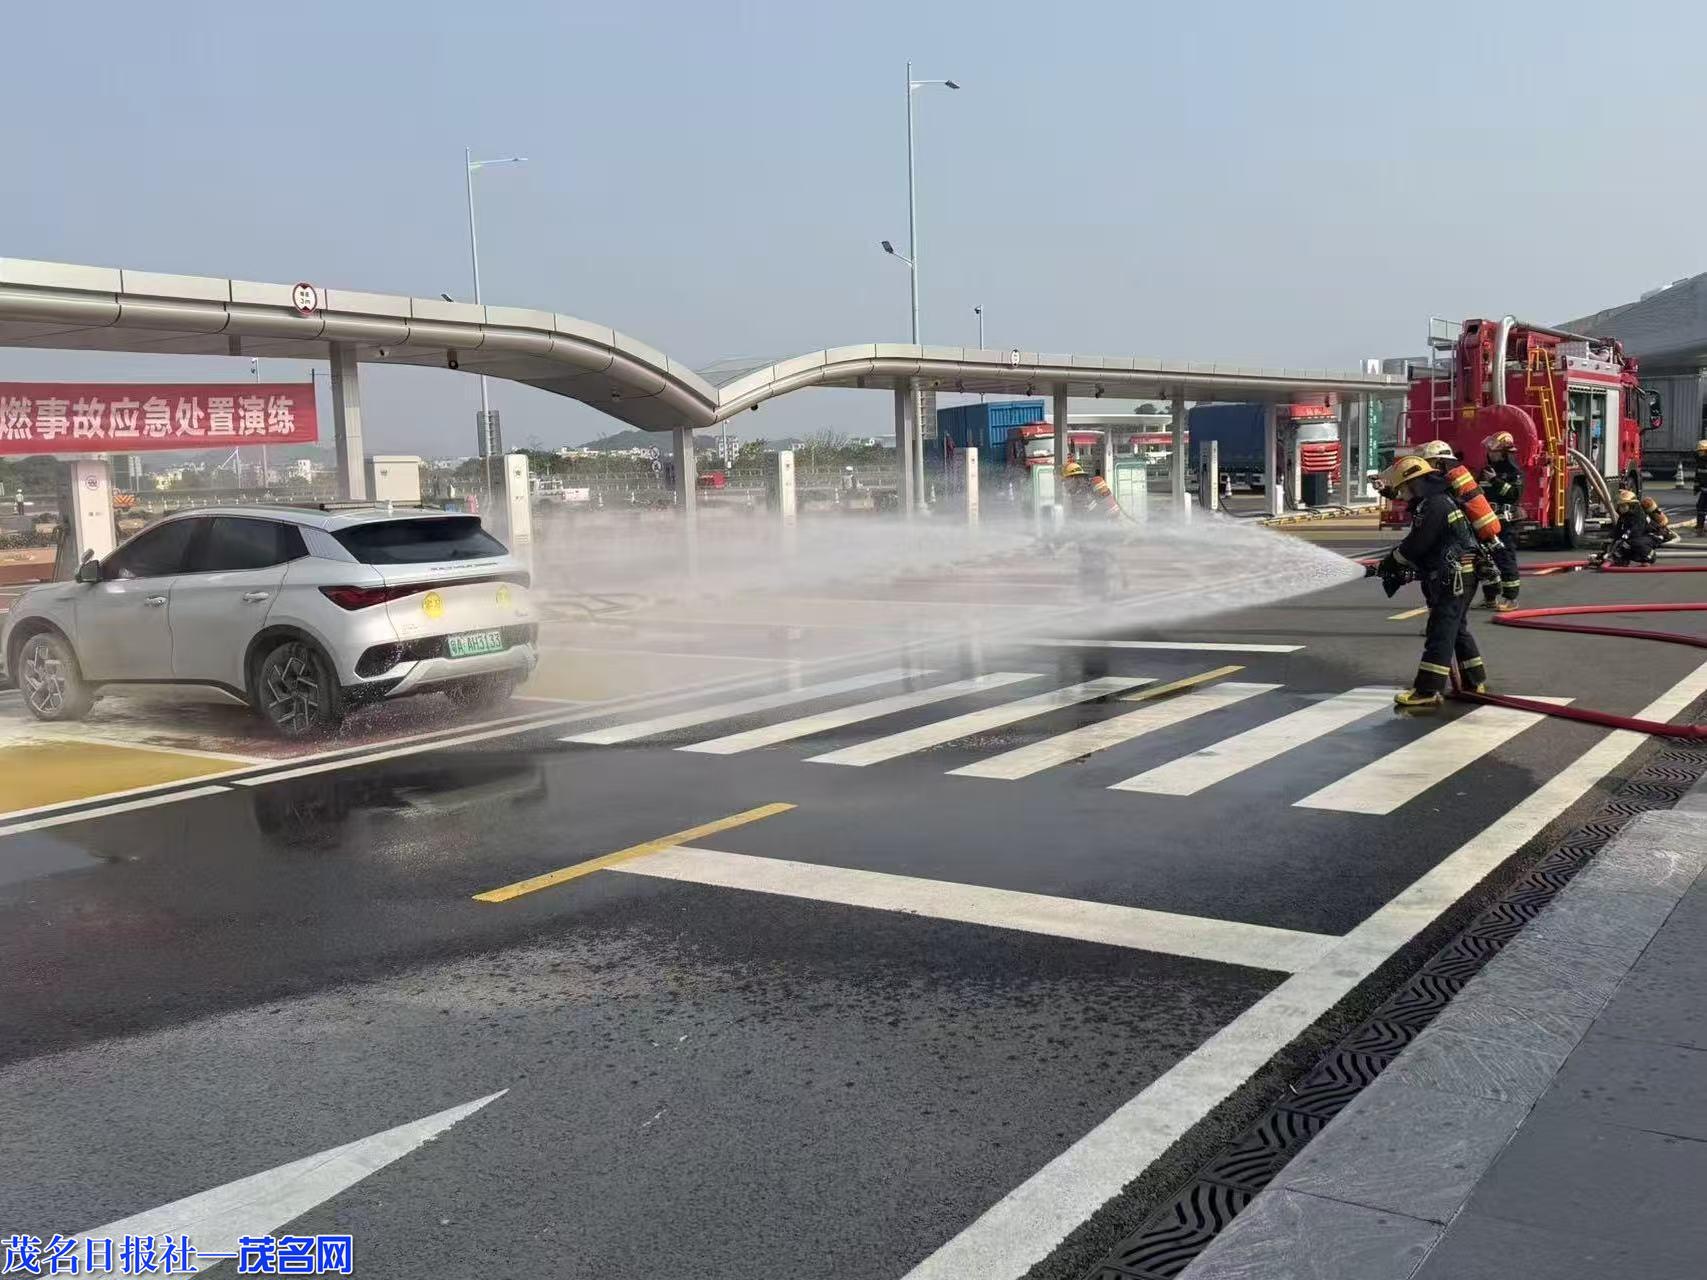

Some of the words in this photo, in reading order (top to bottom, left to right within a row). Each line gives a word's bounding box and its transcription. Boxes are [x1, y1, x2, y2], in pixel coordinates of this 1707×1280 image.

[0, 396, 296, 440] 燃事故应急处置演练
